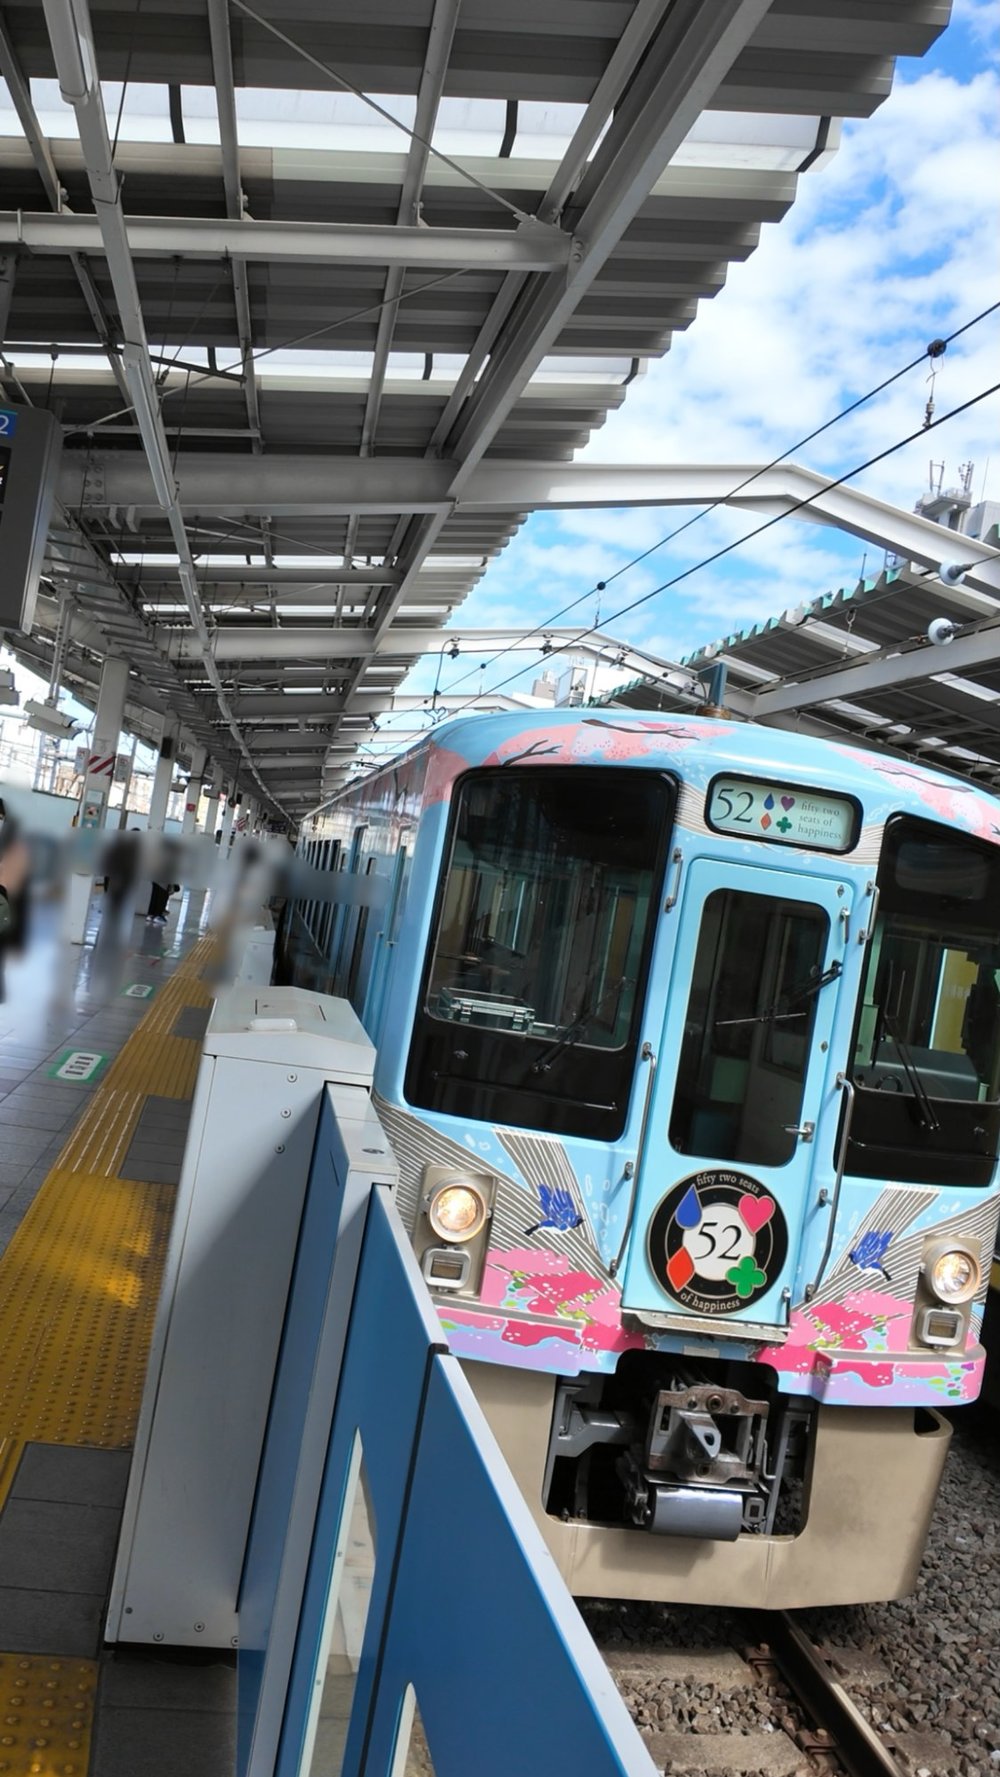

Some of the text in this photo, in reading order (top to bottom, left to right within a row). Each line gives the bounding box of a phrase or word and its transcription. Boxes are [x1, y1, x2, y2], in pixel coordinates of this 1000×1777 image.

[713, 788, 754, 823] 52
[801, 800, 840, 817] fifty two
[799, 813, 833, 827] seats of
[797, 823, 842, 840] happiness
[696, 1173, 760, 1194] fifty two seats
[694, 1222, 742, 1261] 52
[680, 1292, 741, 1313] of happiness
